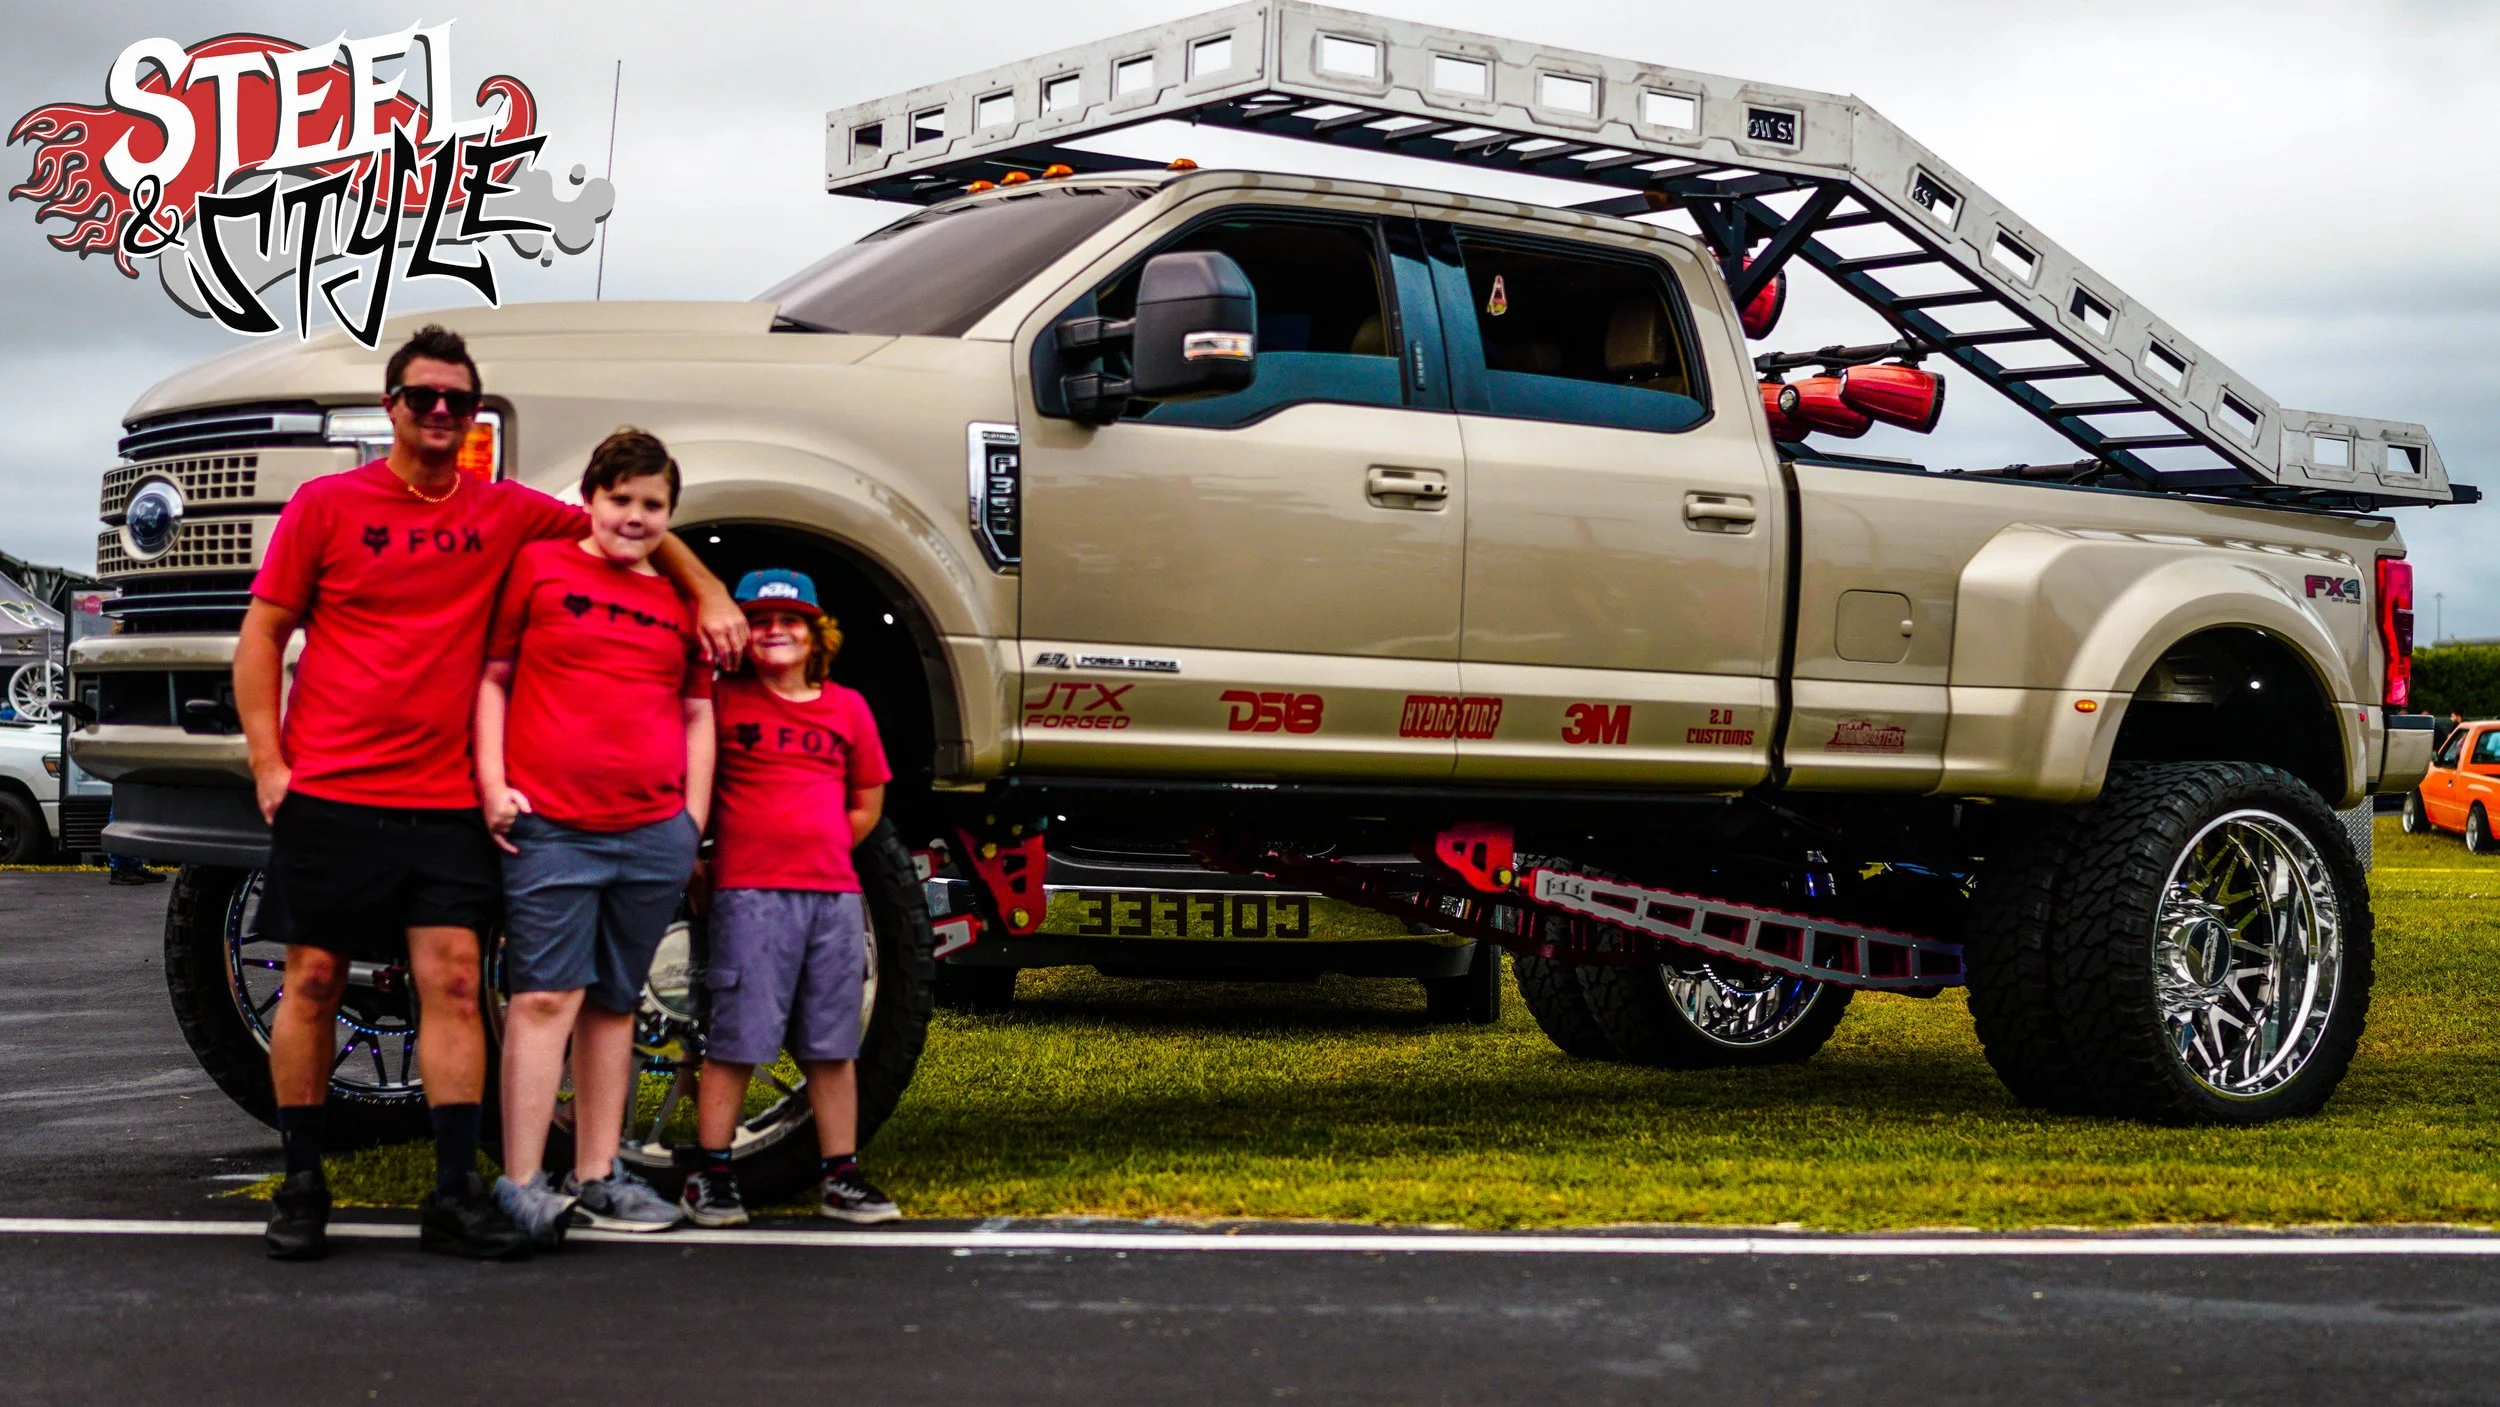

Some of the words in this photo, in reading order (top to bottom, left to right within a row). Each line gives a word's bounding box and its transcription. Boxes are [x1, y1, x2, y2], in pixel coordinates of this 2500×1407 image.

[408, 526, 484, 554] FOX
[2304, 574, 2361, 600] FX4
[1080, 655, 1125, 666] POWER
[1127, 658, 1177, 668] STROKE
[1024, 682, 1136, 712] JTX
[1024, 714, 1131, 730] FORGED
[1219, 690, 1325, 735] DS18
[1561, 703, 1632, 745] 3M
[1709, 708, 1733, 725] 2.0
[1686, 727, 1755, 747] CUSTOMS
